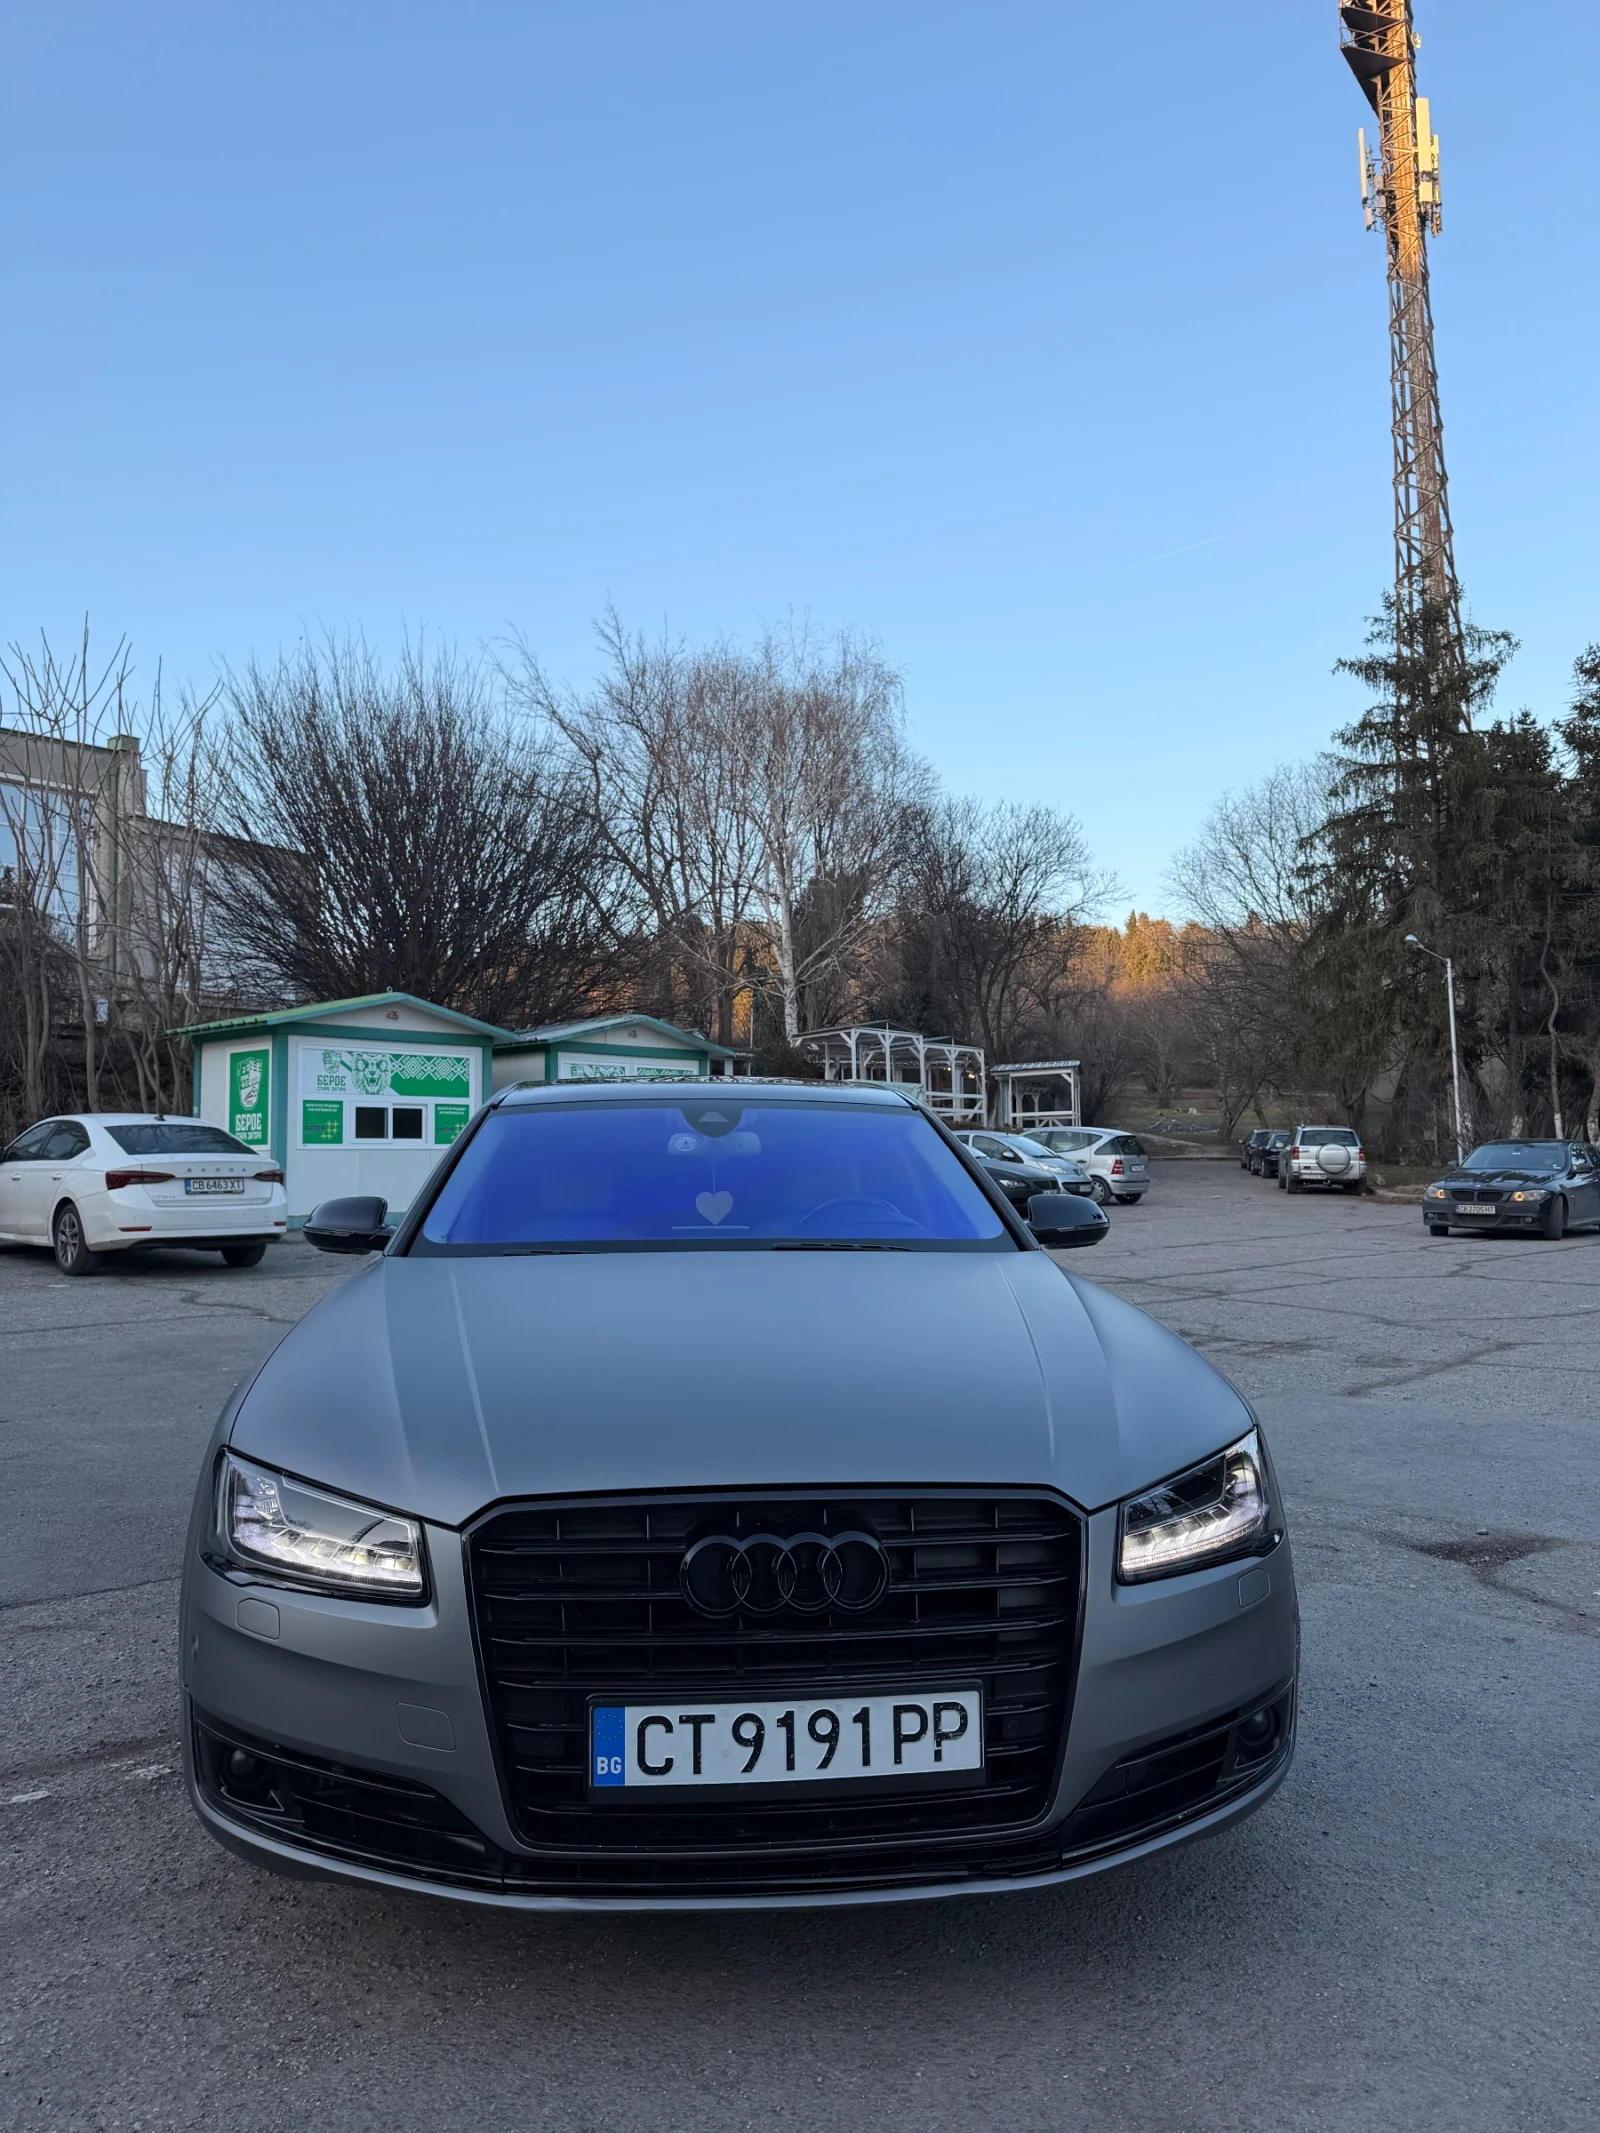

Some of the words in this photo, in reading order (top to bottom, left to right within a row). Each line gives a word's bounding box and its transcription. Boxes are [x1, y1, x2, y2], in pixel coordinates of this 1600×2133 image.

[317, 1075, 346, 1086] БЕРОЕ
[235, 1113, 262, 1132] БЕРОЕ
[192, 1180, 205, 1190] CB
[206, 1180, 228, 1190] 6463
[229, 1180, 241, 1189] XT
[636, 1713, 717, 1776] CT
[731, 1706, 872, 1774] 9191
[892, 1701, 969, 1765] PP
[596, 1756, 622, 1775] BG
